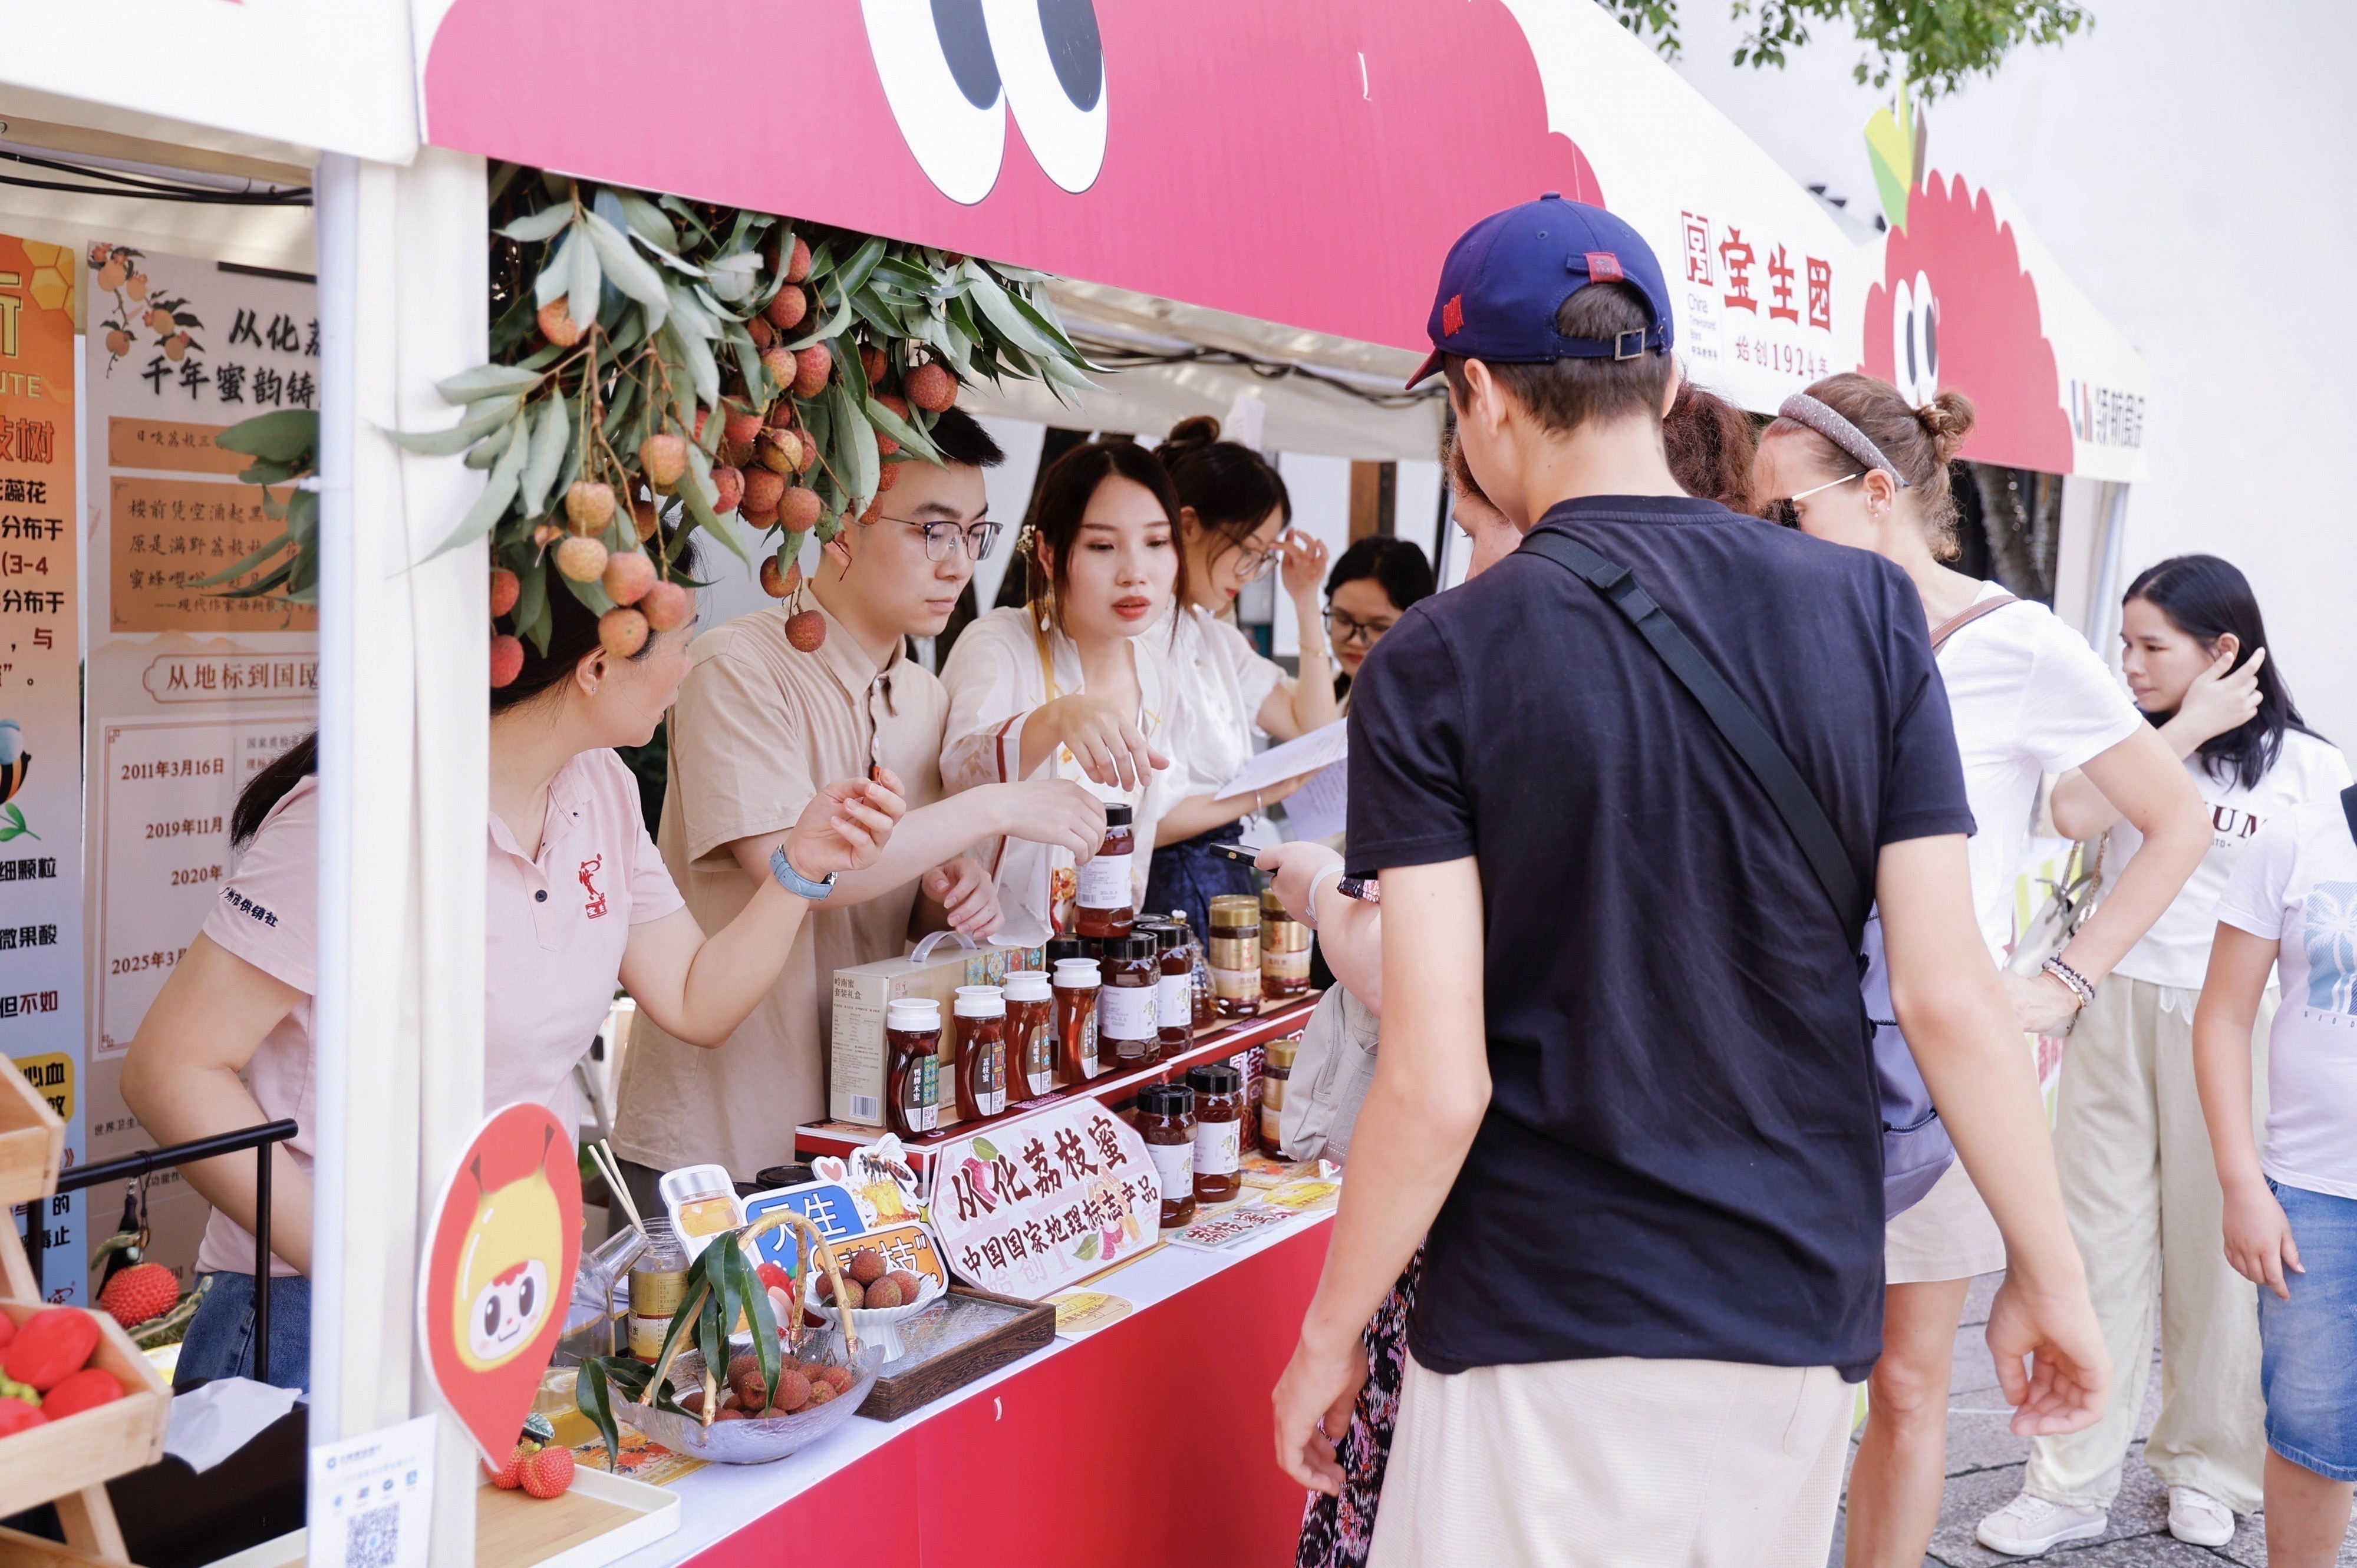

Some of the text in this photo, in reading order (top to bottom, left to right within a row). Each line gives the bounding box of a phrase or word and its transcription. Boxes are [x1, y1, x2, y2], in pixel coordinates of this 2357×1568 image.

[137, 430, 223, 449] 日啖荔枝三
[0, 478, 46, 503] 蕊花
[1, 515, 63, 541] 分布于
[2, 551, 48, 576] (3-4
[2, 589, 64, 613] 分布于
[121, 758, 223, 780] 2011年3月16日
[146, 816, 222, 839] 2019年11月
[171, 864, 222, 886] 2020年
[219, 886, 279, 927] 广州市供销社
[834, 978, 855, 989] 岭南蜜
[835, 988, 862, 1000] 套装礼盒
[0, 991, 58, 1018] 但不如
[982, 1058, 990, 1082] 荔枝蜜
[913, 1068, 921, 1101] 鸭脚木蜜
[94, 1117, 141, 1136] 世界卫生
[951, 1115, 1128, 1222] 从化荔枝蜜
[962, 1175, 1159, 1281] 中国国家地理标志产品
